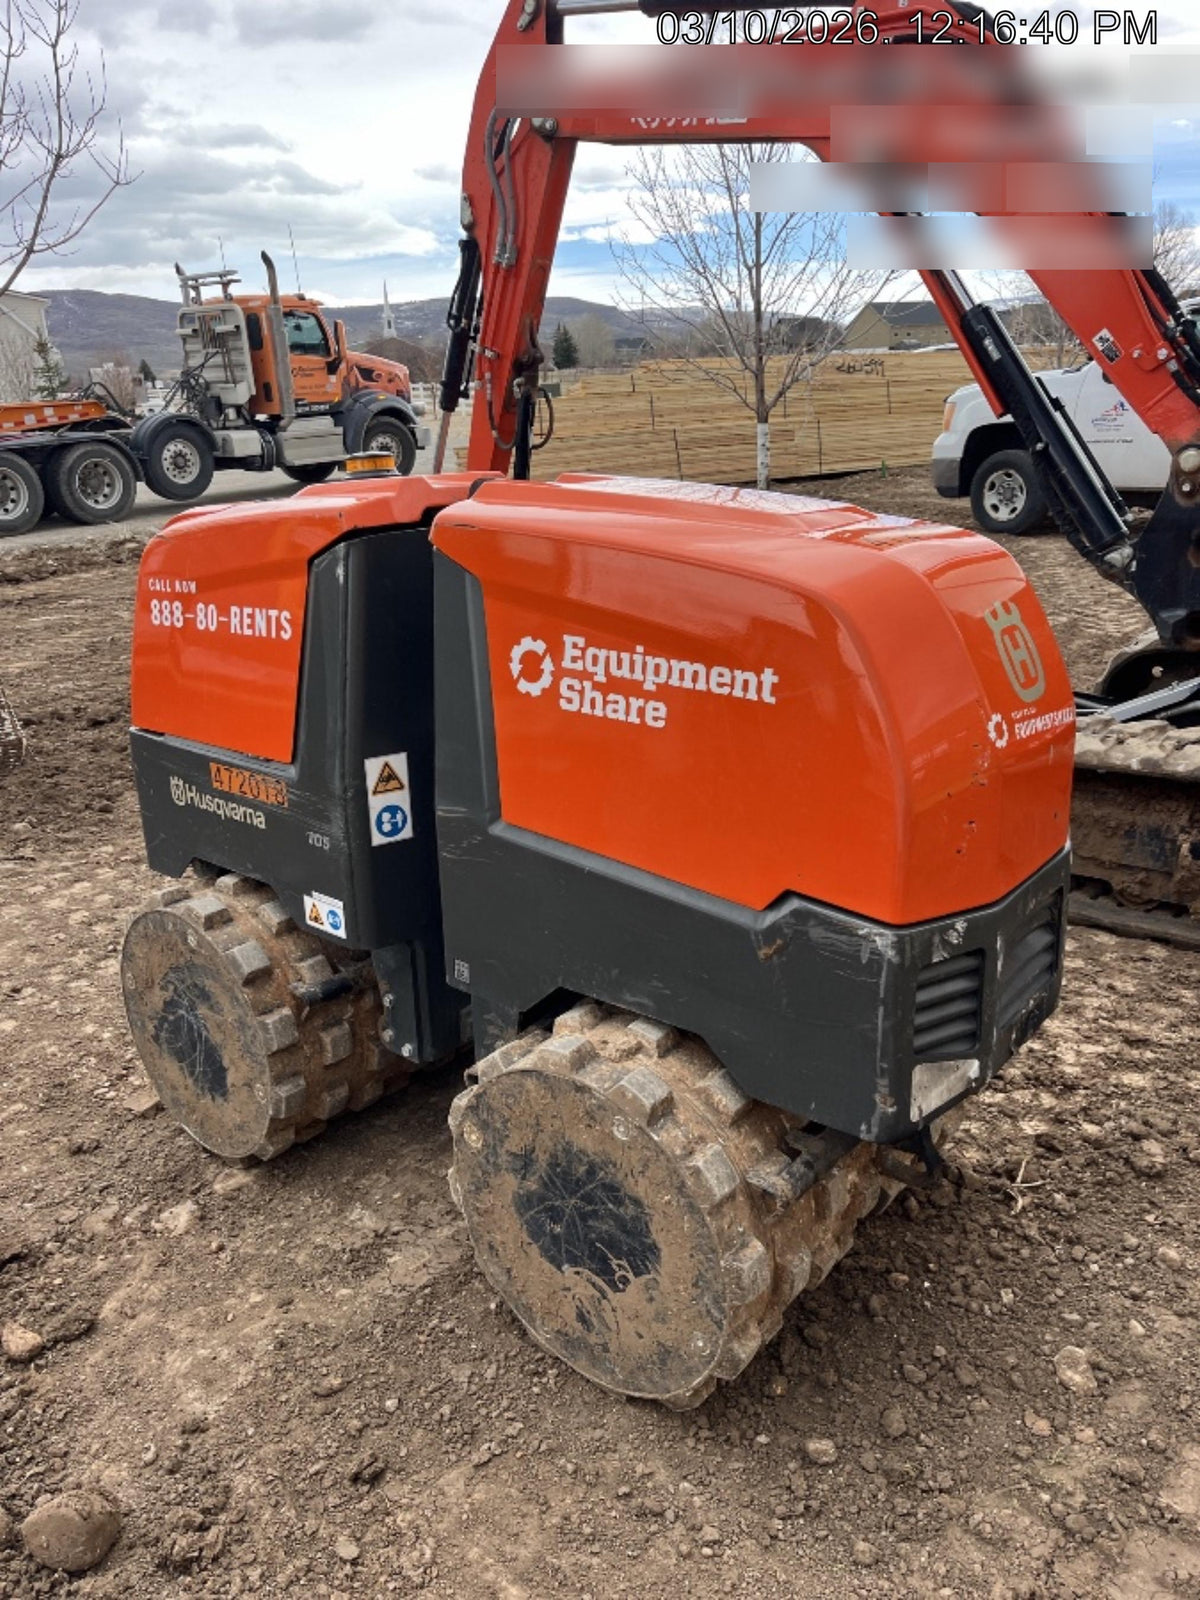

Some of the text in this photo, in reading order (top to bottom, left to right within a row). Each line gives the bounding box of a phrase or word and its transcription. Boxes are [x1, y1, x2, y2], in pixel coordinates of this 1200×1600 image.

[148, 578, 196, 594] CALL NOW
[150, 598, 293, 640] 888-80-RENTS
[561, 634, 780, 704] Equipment
[559, 677, 667, 728] Share
[185, 783, 266, 829] Husqvarna
